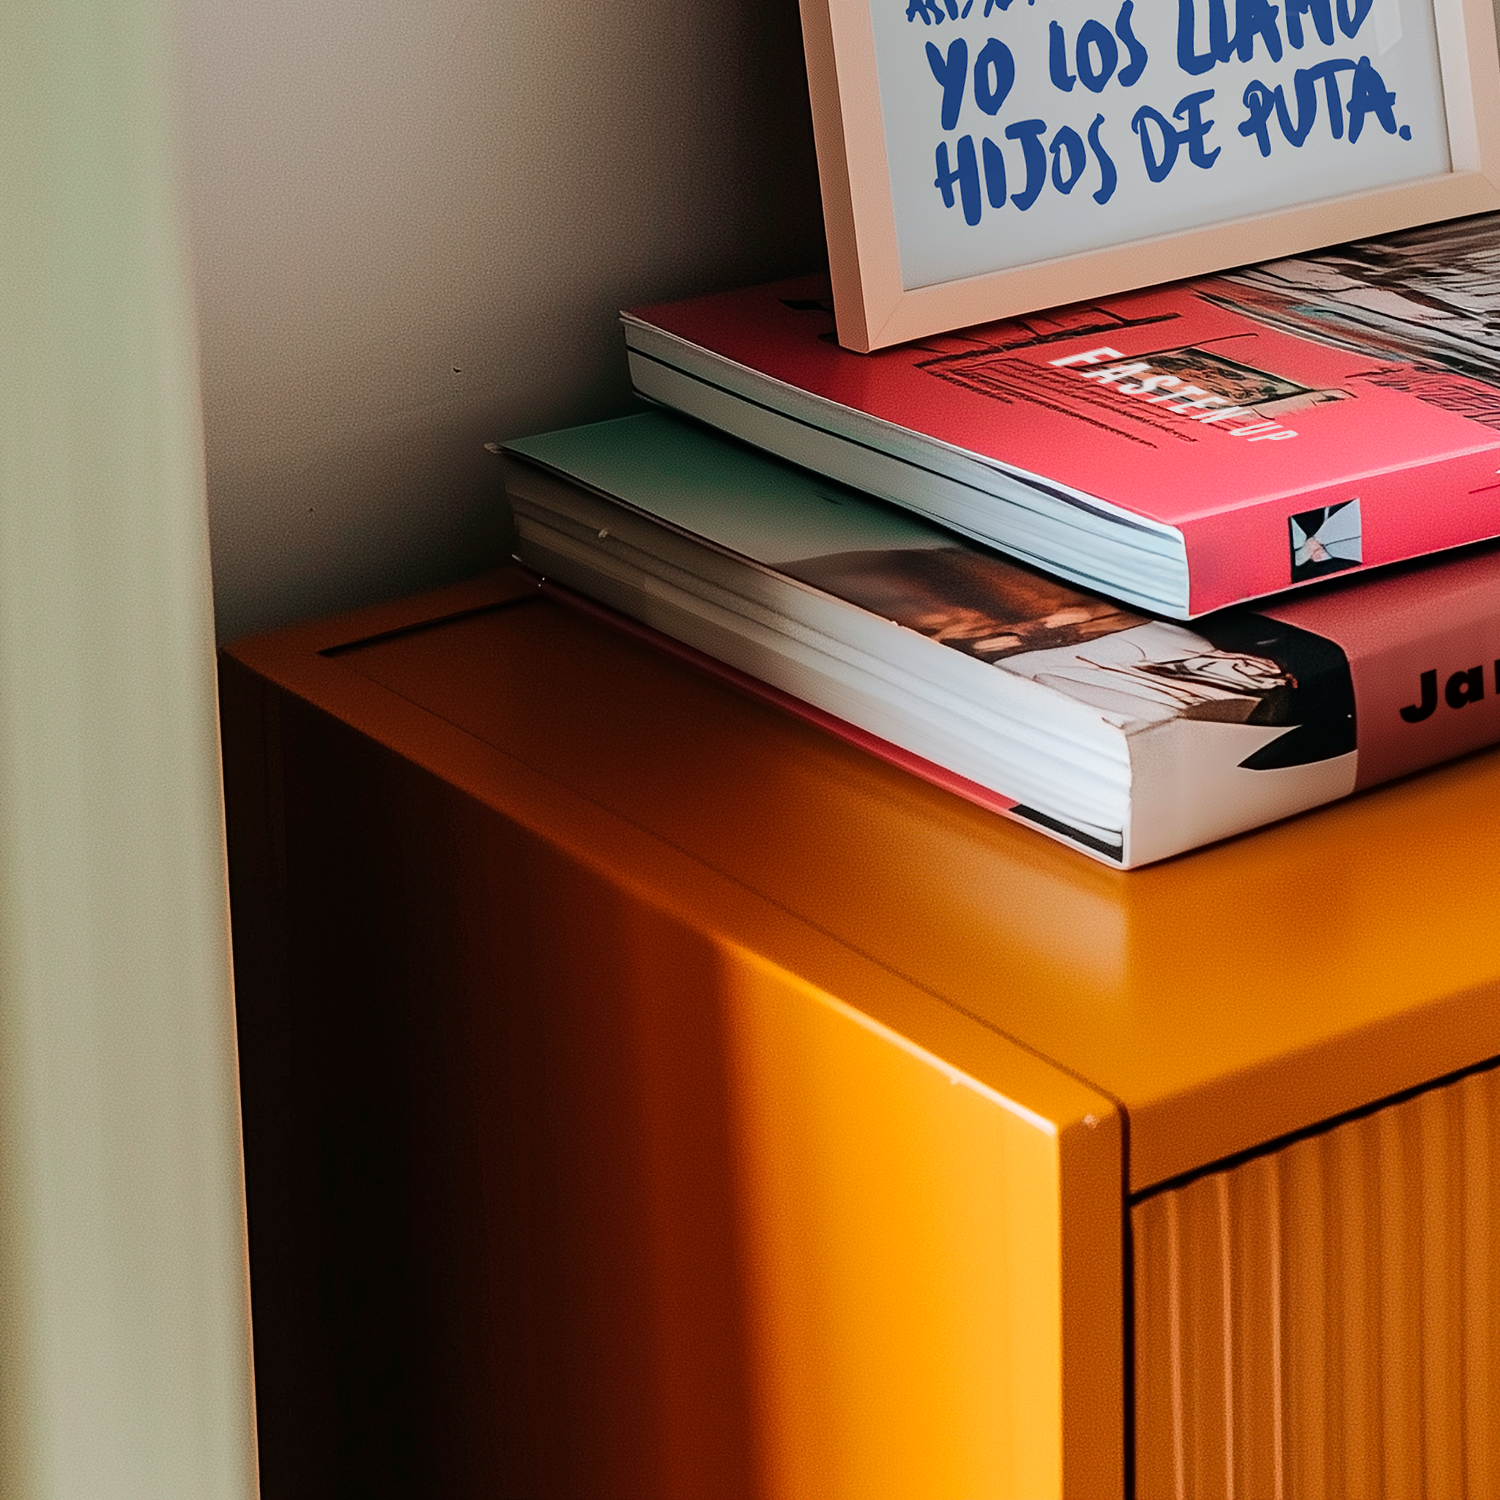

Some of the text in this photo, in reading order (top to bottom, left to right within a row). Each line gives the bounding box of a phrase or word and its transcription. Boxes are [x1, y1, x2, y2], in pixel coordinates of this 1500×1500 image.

[924, 37, 1016, 131] YO
[1048, 0, 1149, 94] LOS
[933, 55, 1412, 227] HIJOS DE PUTA.
[1048, 347, 1298, 442] FASTEN UP
